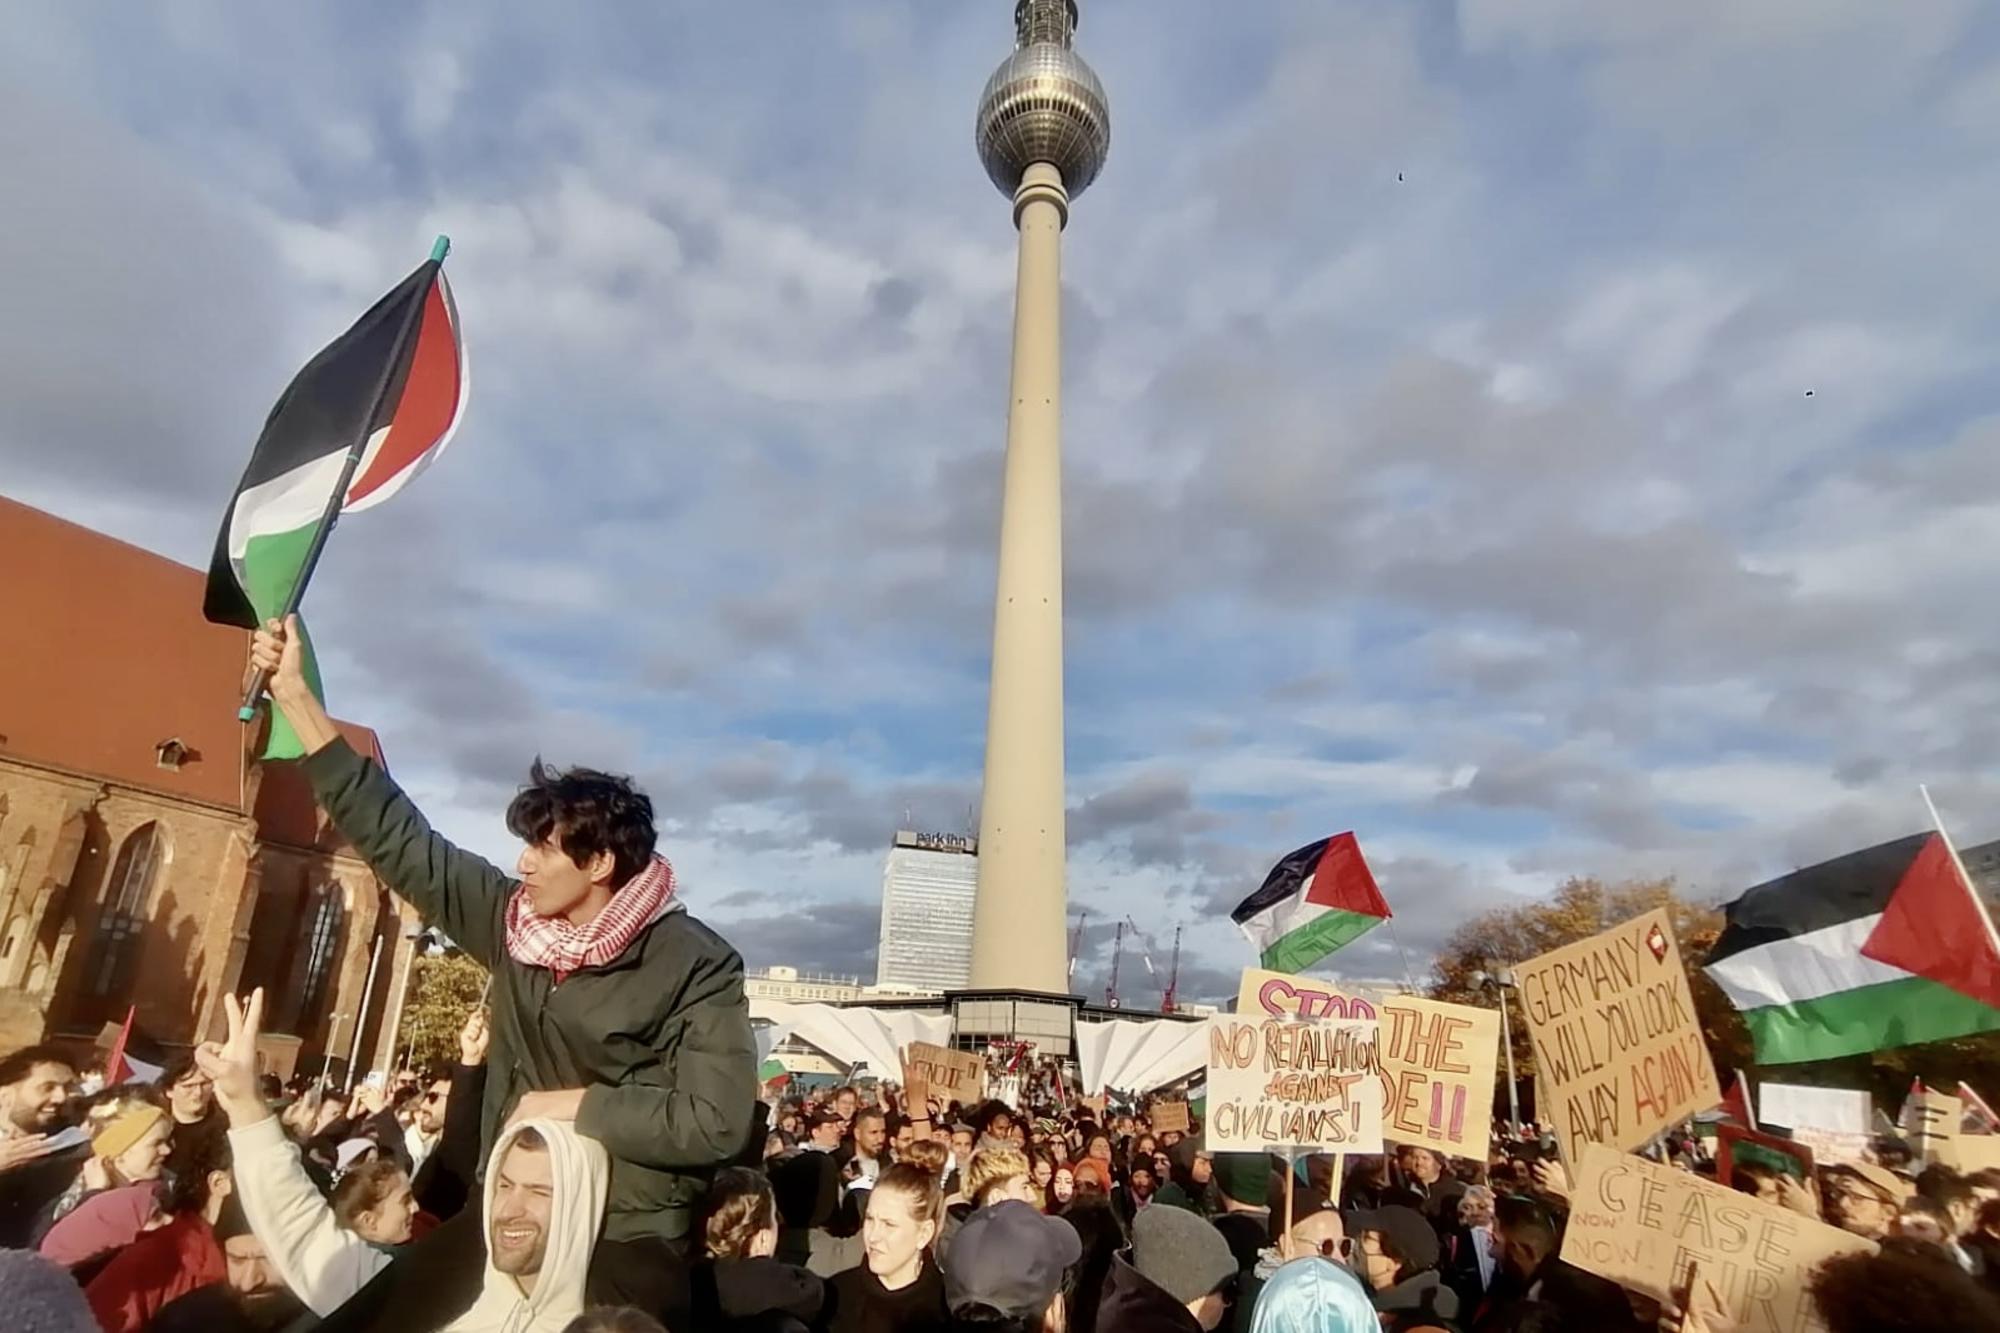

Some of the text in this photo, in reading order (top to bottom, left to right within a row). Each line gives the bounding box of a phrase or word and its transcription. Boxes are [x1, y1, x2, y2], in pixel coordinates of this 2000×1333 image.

[1524, 928, 1641, 1026] GERMANY
[1210, 1022, 1257, 1069] NO
[1384, 1007, 1473, 1074] THE
[1538, 974, 1690, 1087] WILL YOU LOOK
[1214, 1097, 1360, 1144] CIVILIANS!
[1265, 1071, 1364, 1111] AGAINST
[1567, 1032, 1710, 1163] AWAY AGAIN?
[1598, 1166, 1798, 1274] CEASE
